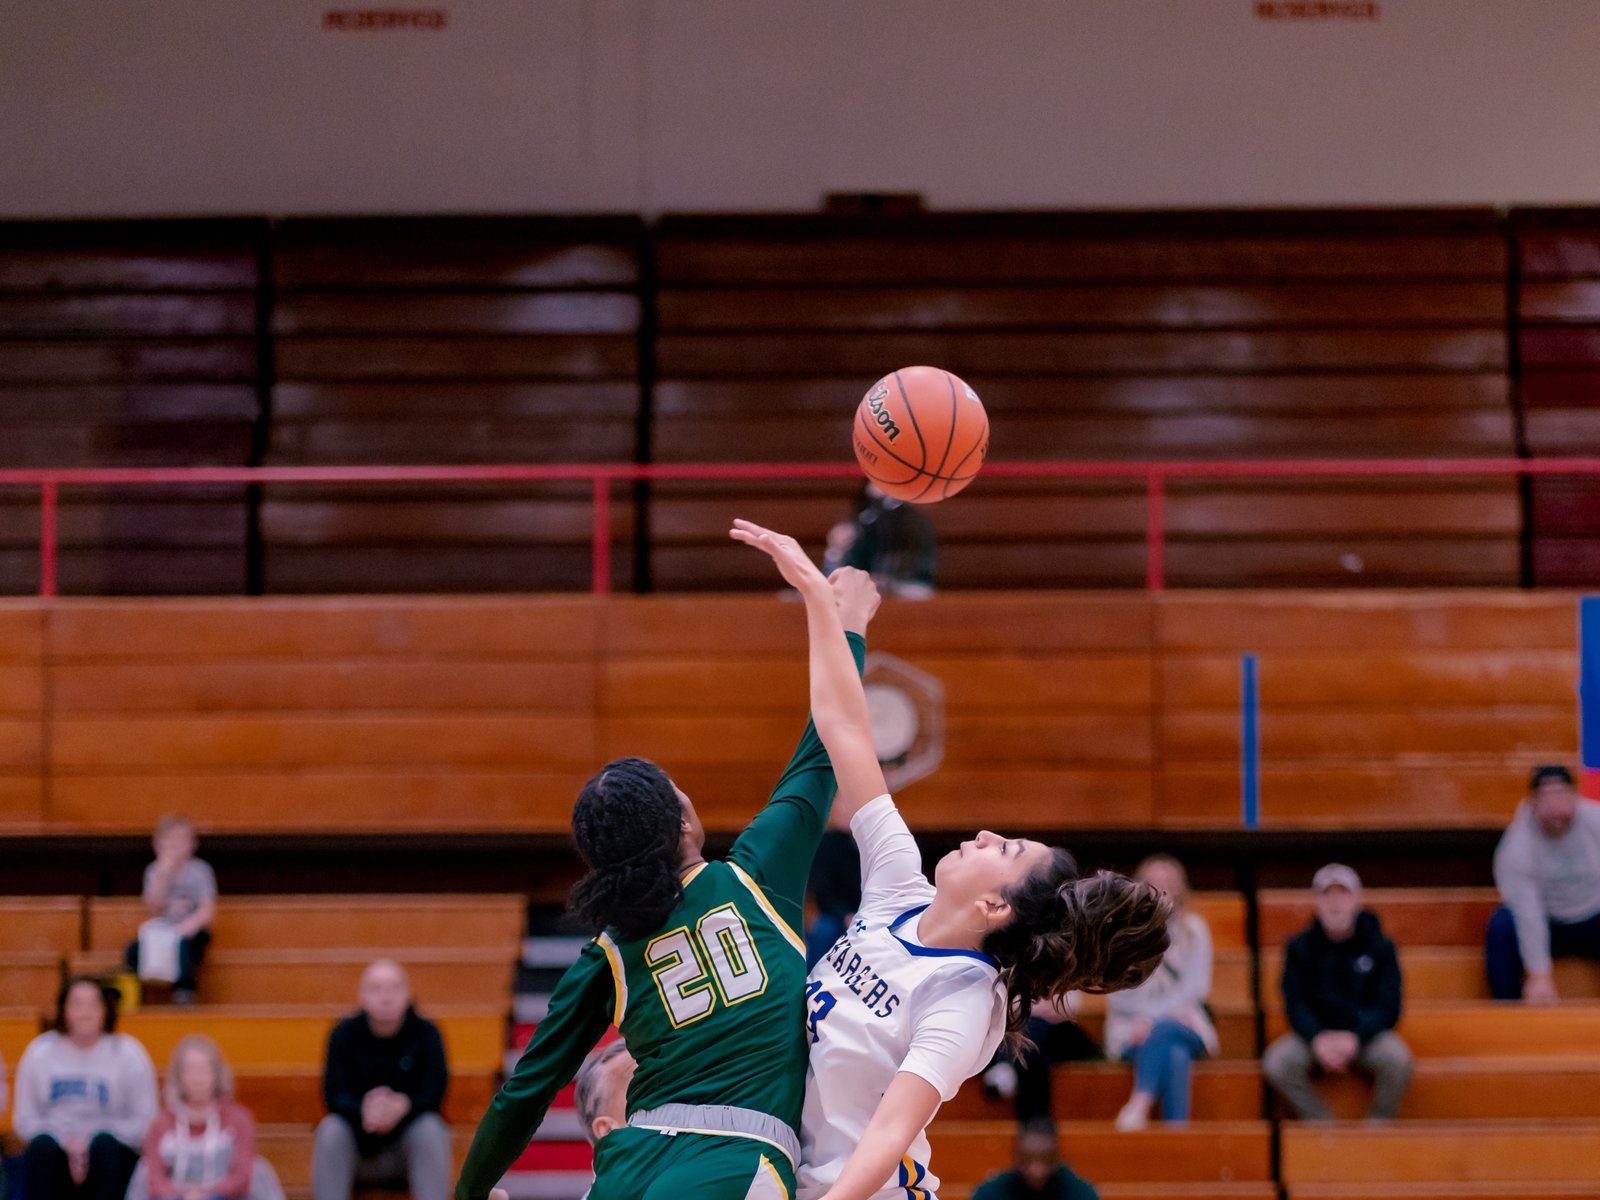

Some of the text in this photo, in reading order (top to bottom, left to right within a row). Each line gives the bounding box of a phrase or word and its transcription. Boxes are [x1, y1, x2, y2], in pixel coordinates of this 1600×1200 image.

[867, 379, 900, 442] lson
[645, 902, 768, 1029] 20
[827, 932, 900, 1018] ARGERS
